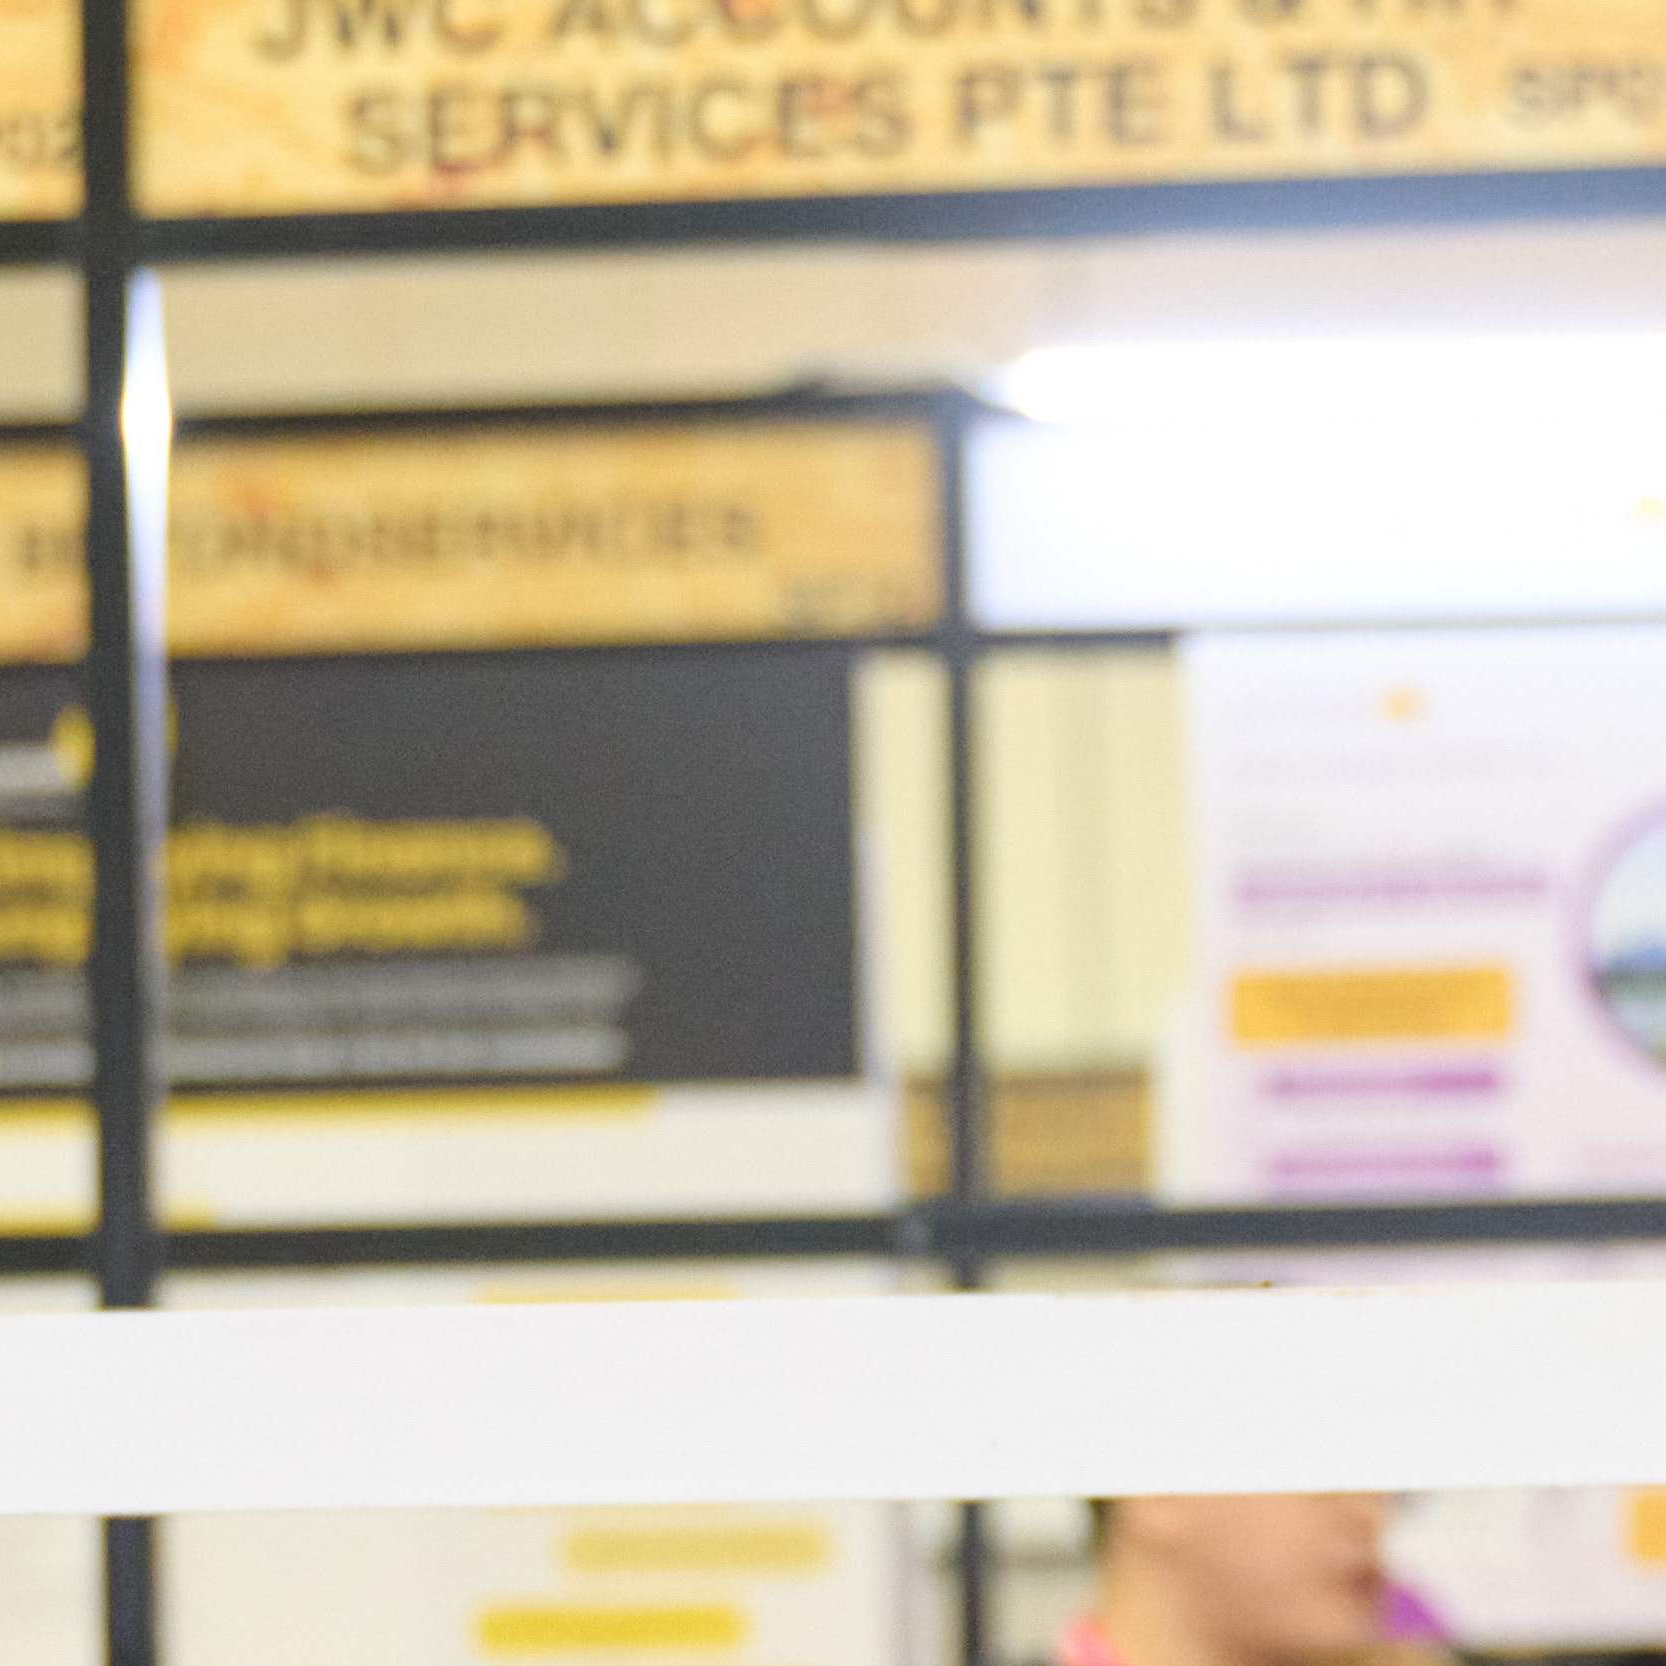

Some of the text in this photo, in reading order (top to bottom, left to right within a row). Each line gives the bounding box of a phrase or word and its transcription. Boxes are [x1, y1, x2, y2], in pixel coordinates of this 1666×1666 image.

[347, 48, 1433, 174] SERVICES PTE LTD
